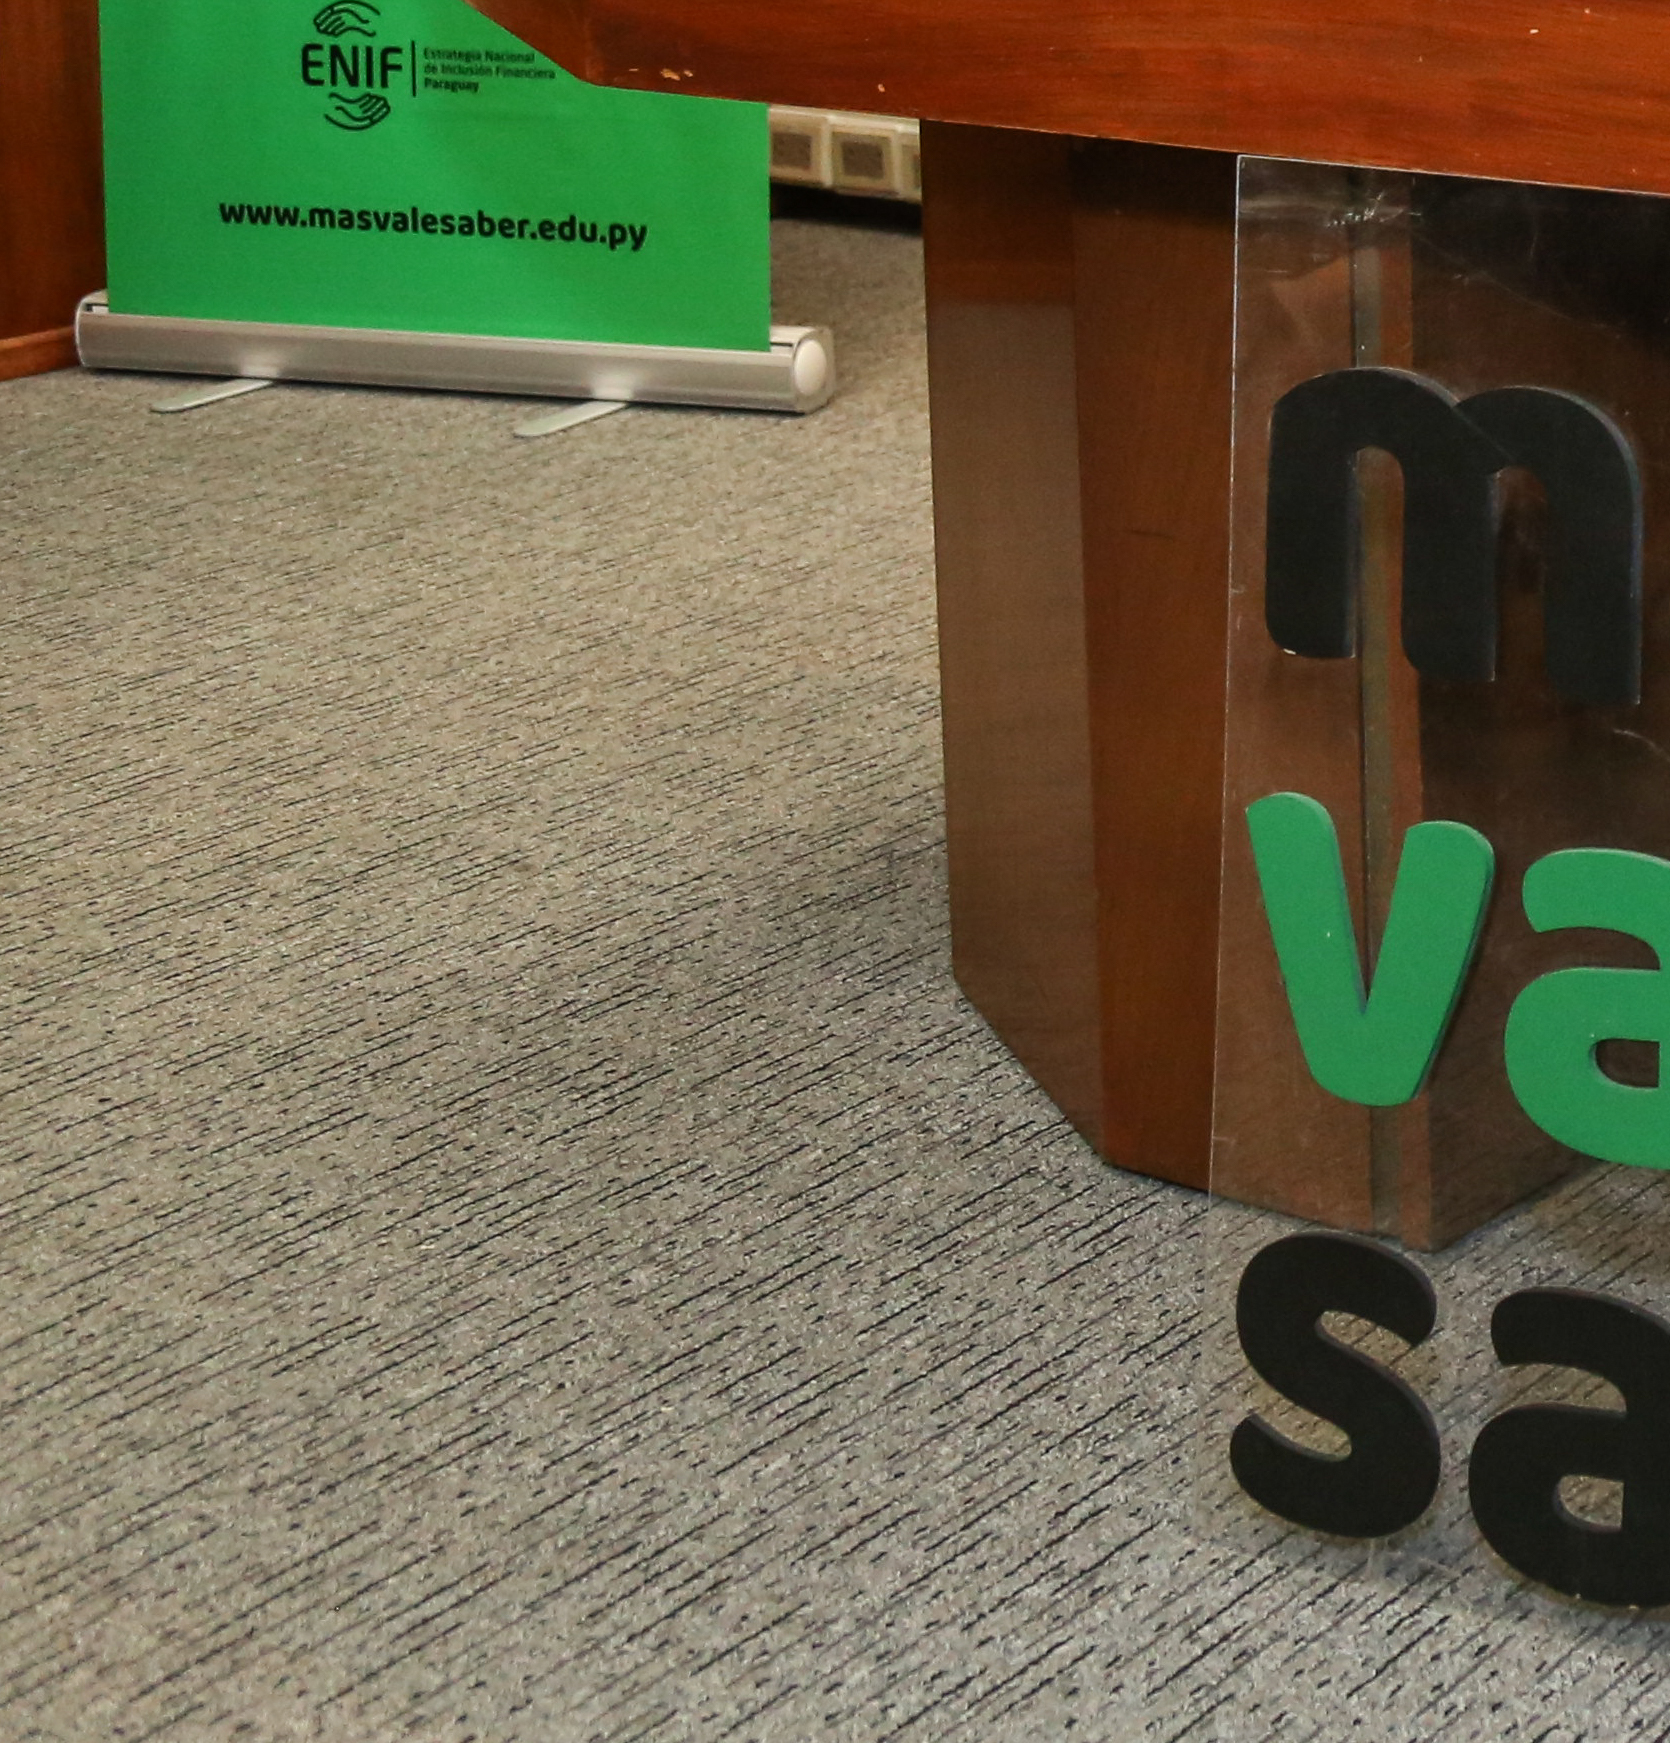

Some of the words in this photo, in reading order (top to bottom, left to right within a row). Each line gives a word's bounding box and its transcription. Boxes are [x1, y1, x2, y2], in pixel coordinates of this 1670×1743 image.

[485, 50, 535, 63] Nacional
[301, 42, 403, 89] ENIF
[424, 63, 439, 74] de
[424, 77, 479, 93] Paraguay
[218, 202, 648, 252] www.masvalesaber.edu.py
